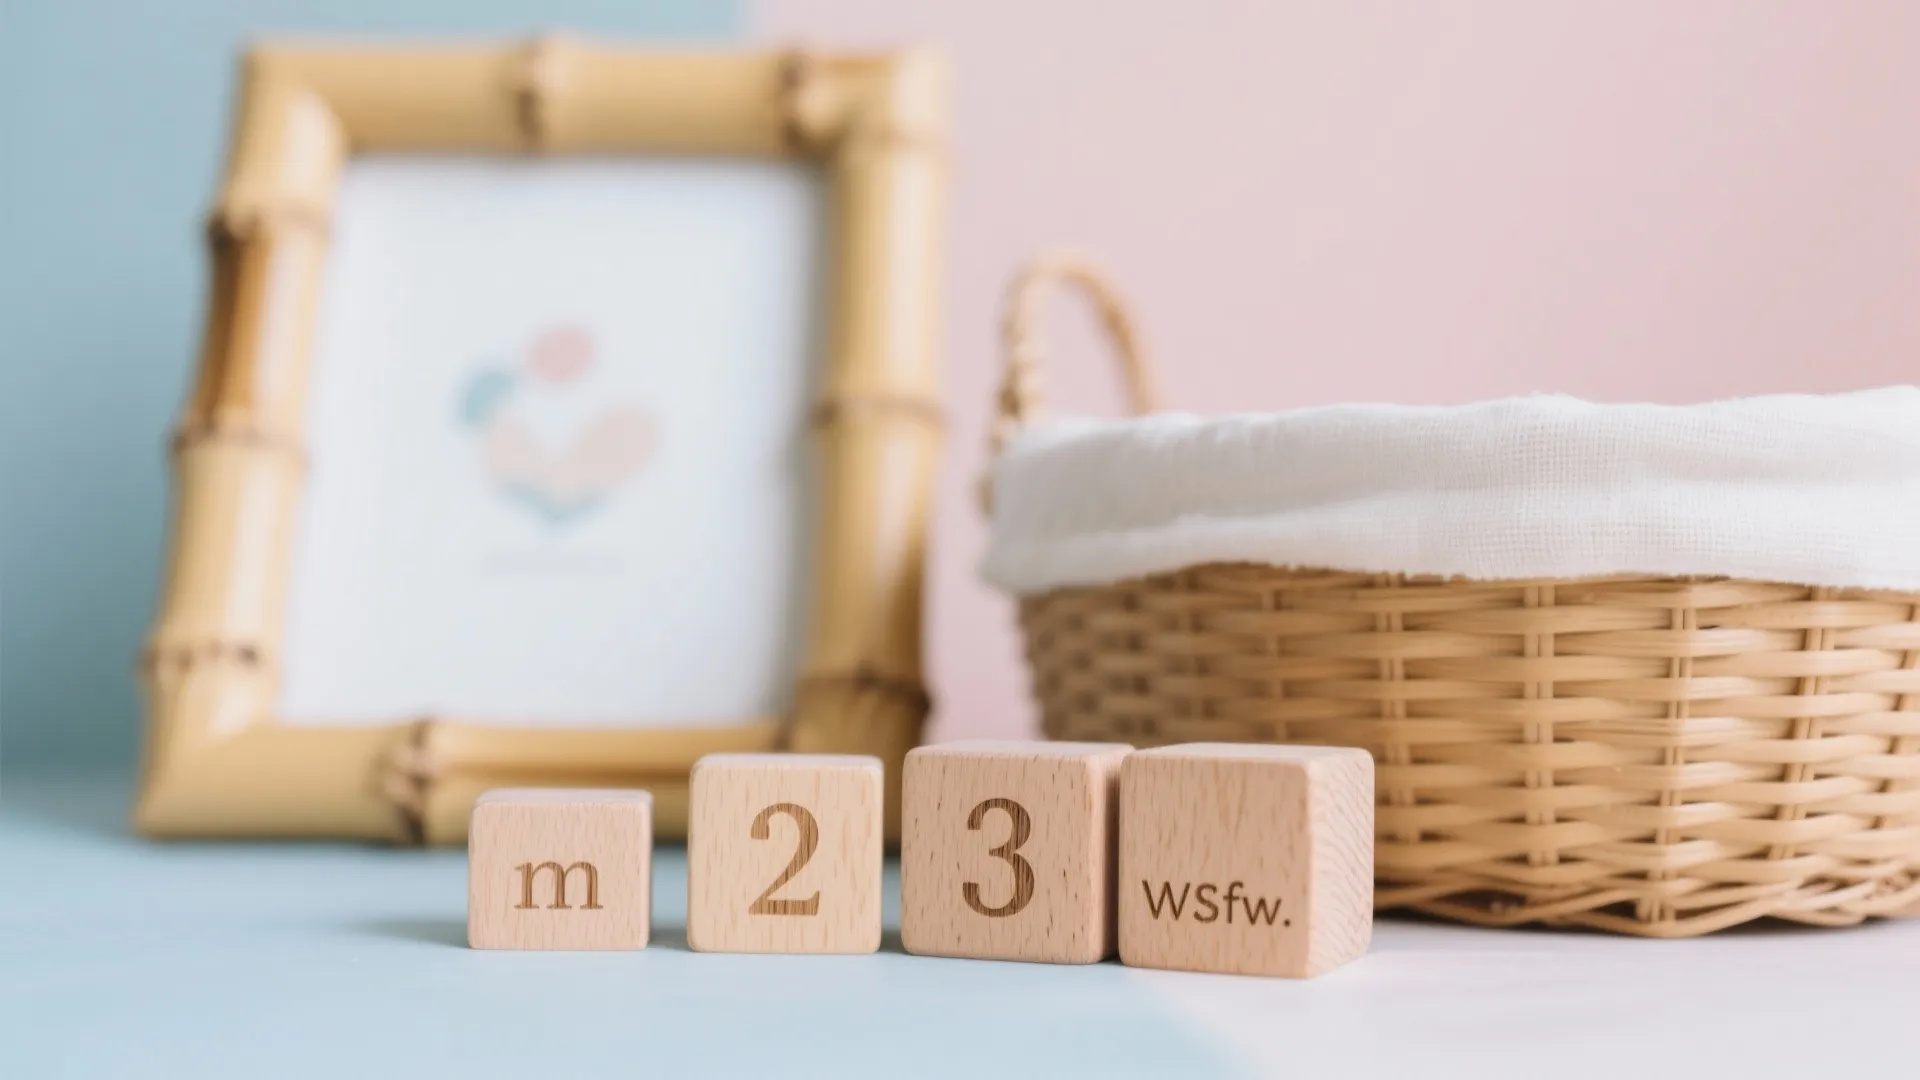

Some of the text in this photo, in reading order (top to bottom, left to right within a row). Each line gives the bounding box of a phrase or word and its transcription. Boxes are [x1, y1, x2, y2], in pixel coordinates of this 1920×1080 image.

[514, 860, 603, 910] m
[748, 802, 820, 916] 2
[962, 797, 1035, 917] 3
